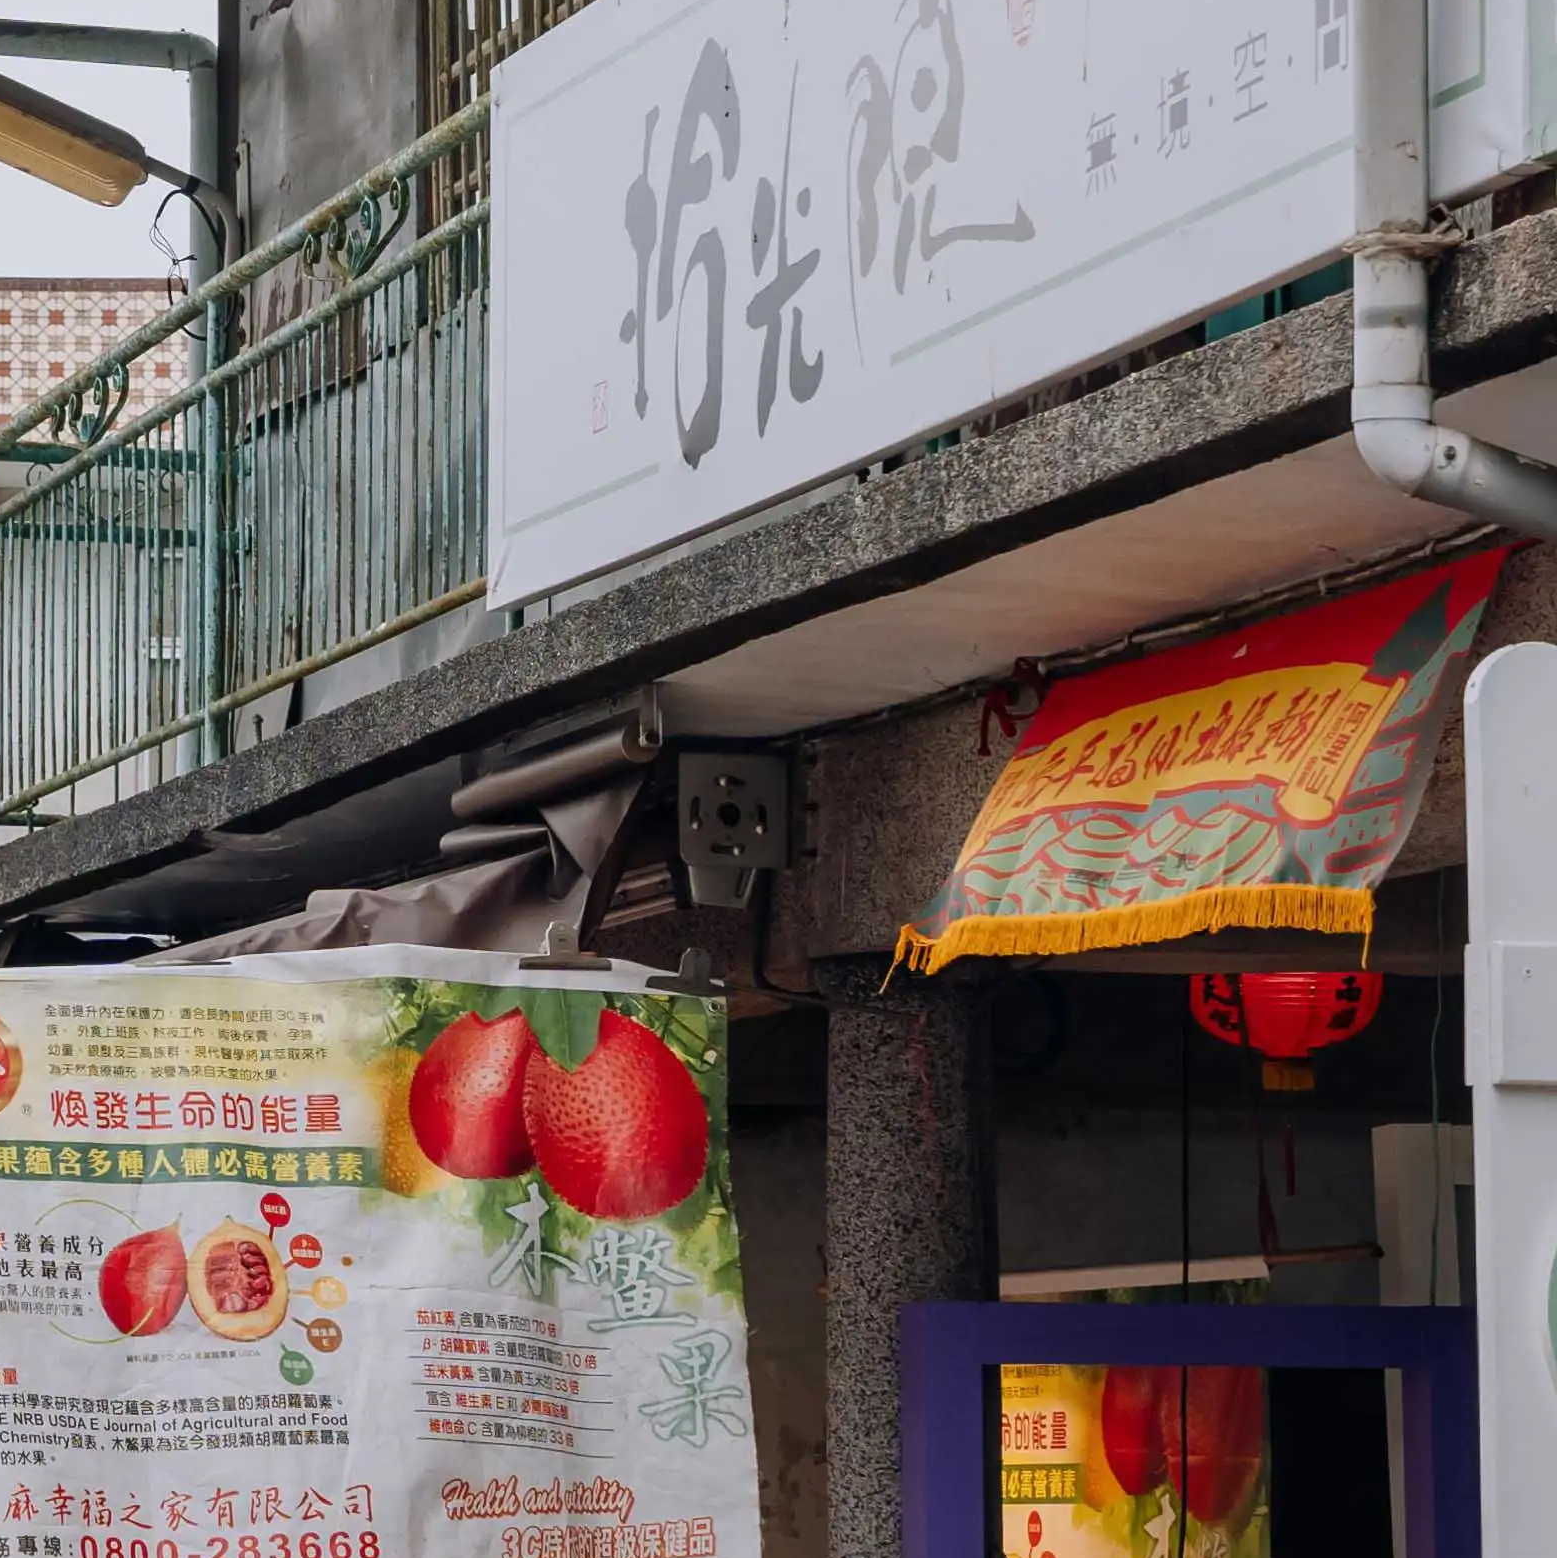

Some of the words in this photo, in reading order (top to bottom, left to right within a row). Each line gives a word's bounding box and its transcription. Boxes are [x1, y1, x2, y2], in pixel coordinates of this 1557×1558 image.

[50, 1089, 343, 1133] 煥發生命的能量
[496, 1395, 506, 1410] E
[13, 1413, 44, 1428] NRB
[48, 1414, 87, 1430] USDA
[103, 1416, 158, 1434] Journal
[161, 1417, 179, 1432] of
[181, 1414, 274, 1434] Agricultural
[277, 1412, 307, 1427] and
[311, 1411, 349, 1427] Food
[441, 1474, 521, 1521] Health
[523, 1476, 563, 1516] and
[563, 1475, 635, 1525] vitality
